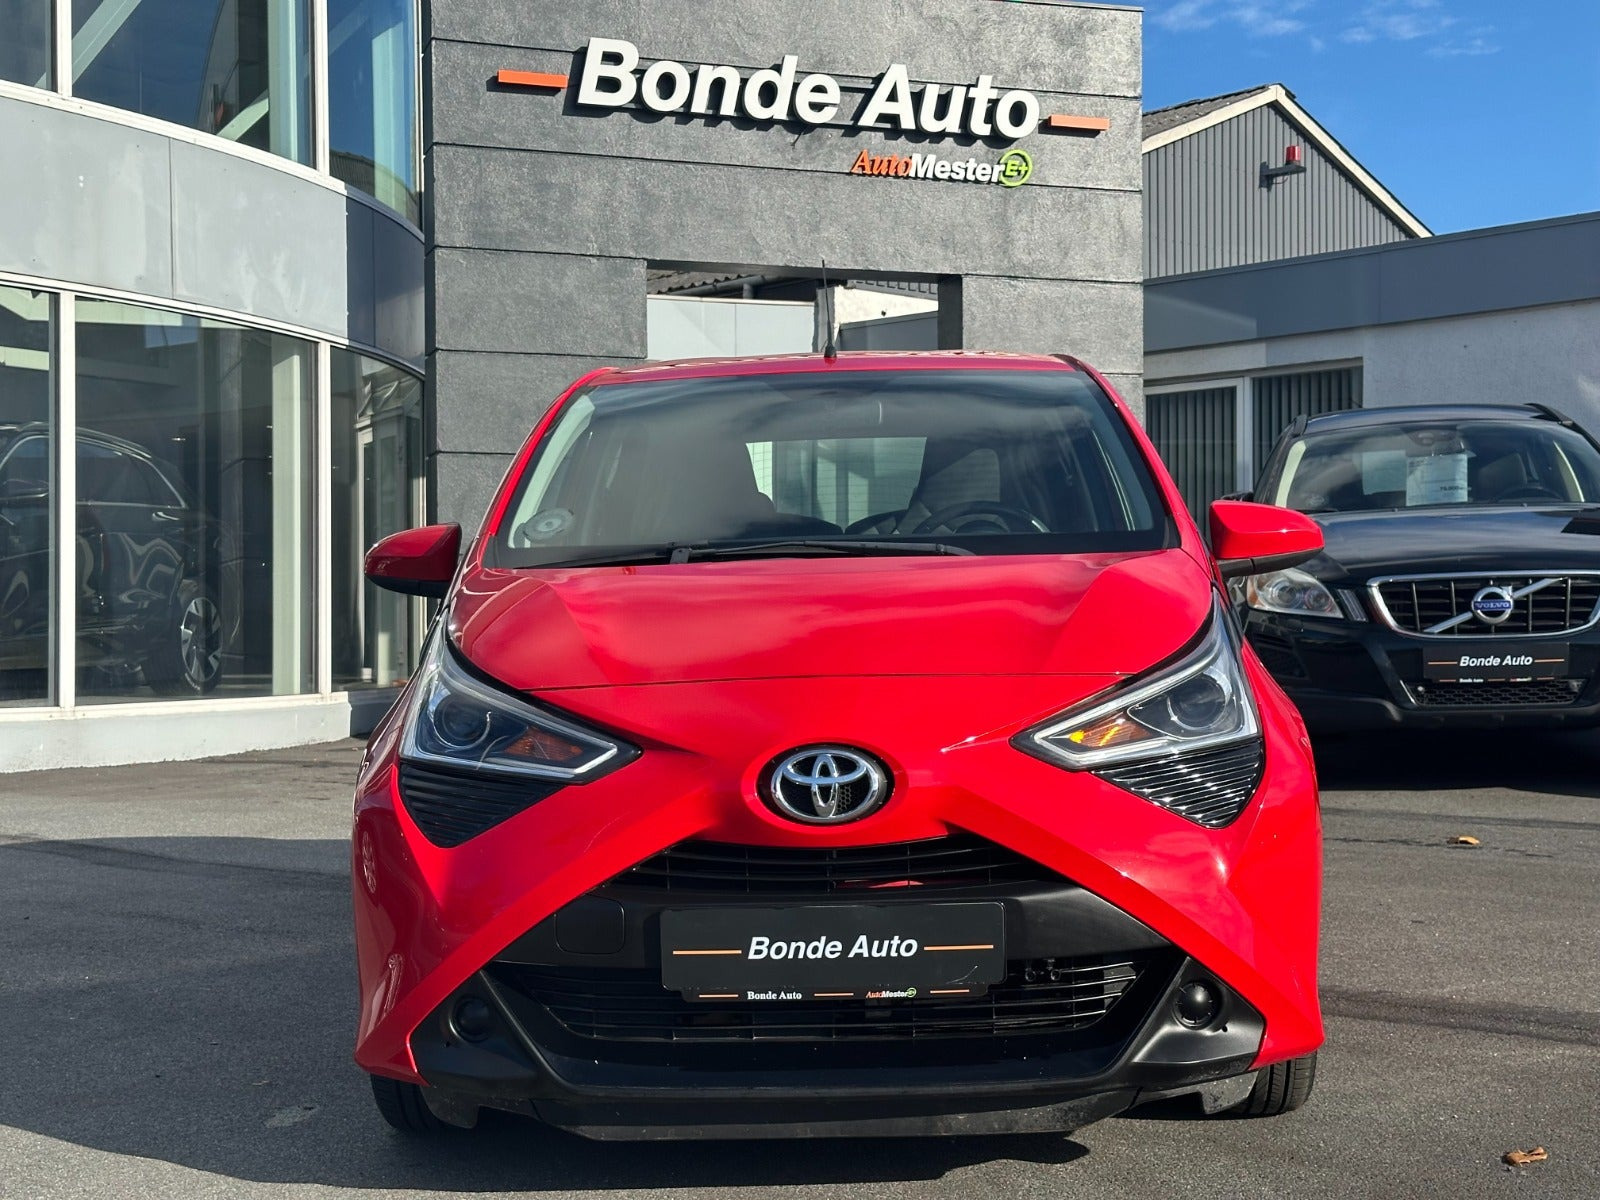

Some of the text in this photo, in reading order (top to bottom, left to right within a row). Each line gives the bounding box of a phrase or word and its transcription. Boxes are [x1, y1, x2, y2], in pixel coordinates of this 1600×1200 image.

[577, 36, 1041, 140] Bonde Auto
[850, 148, 1005, 183] AutoMester
[1459, 654, 1533, 667] Bonde Auto
[747, 934, 918, 960] Bonde Auto
[747, 990, 803, 1000] Bonde Auto
